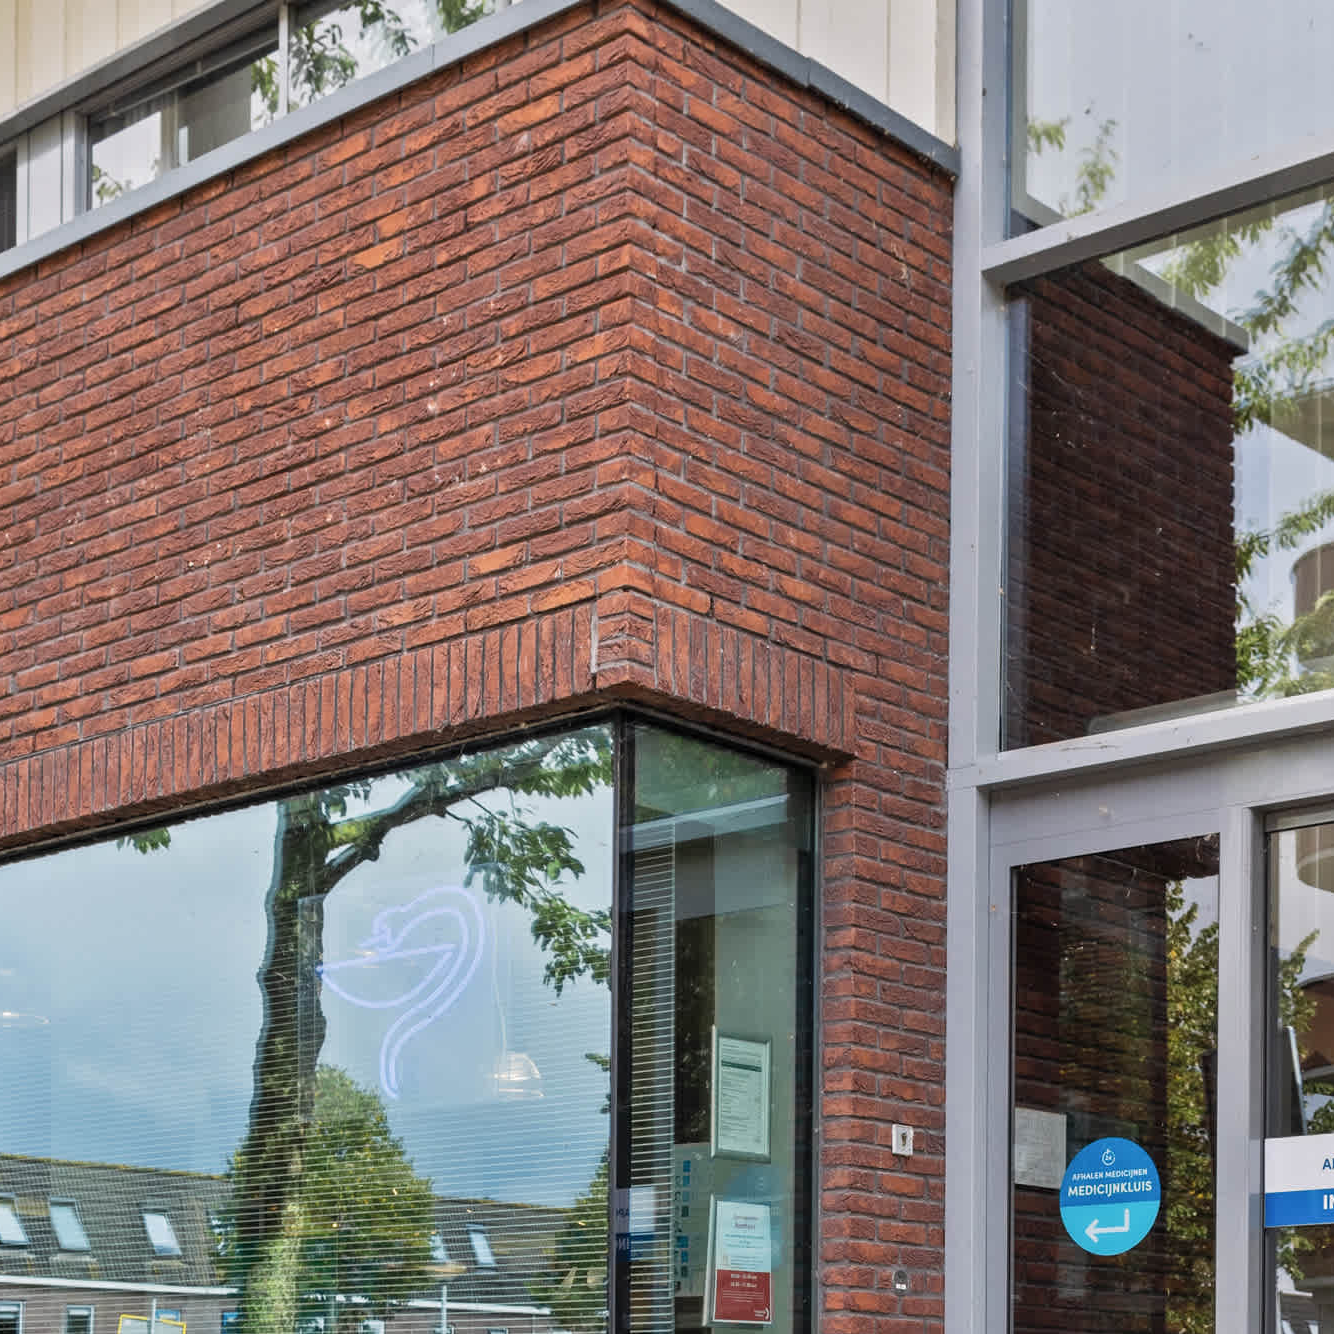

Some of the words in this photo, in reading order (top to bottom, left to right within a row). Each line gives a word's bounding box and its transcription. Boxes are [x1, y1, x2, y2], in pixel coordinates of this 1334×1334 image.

[1072, 1171, 1104, 1181] AFHALEN
[1105, 1167, 1148, 1178] MEDICIJNEN
[1068, 1180, 1154, 1198] MEDICIJNKLUIS
